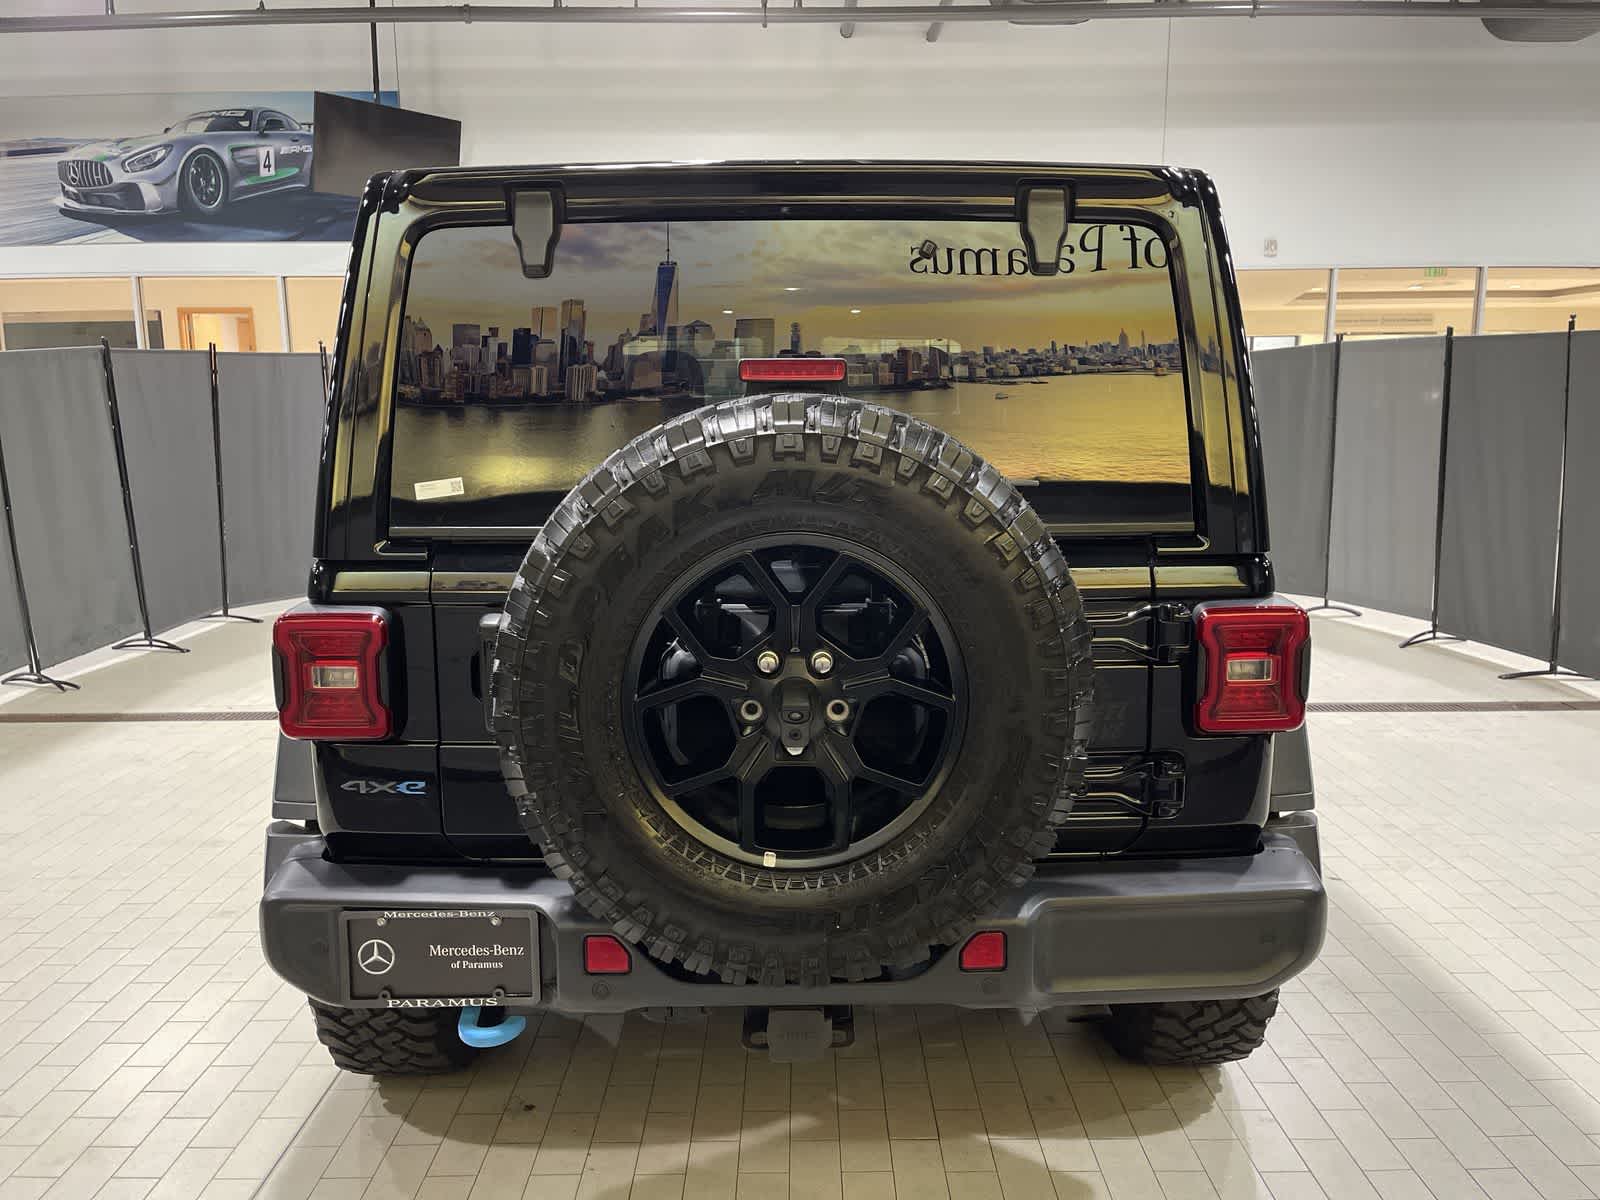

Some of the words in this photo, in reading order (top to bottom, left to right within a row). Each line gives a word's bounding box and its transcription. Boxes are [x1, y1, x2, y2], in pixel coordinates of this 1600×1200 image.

[263, 150, 272, 173] 4
[383, 910, 496, 919] Mercedes-Benz
[429, 944, 525, 957] Mercedes-Benz
[451, 960, 461, 969] of
[462, 960, 504, 969] Paramus
[387, 998, 498, 1008] PARAMUS
